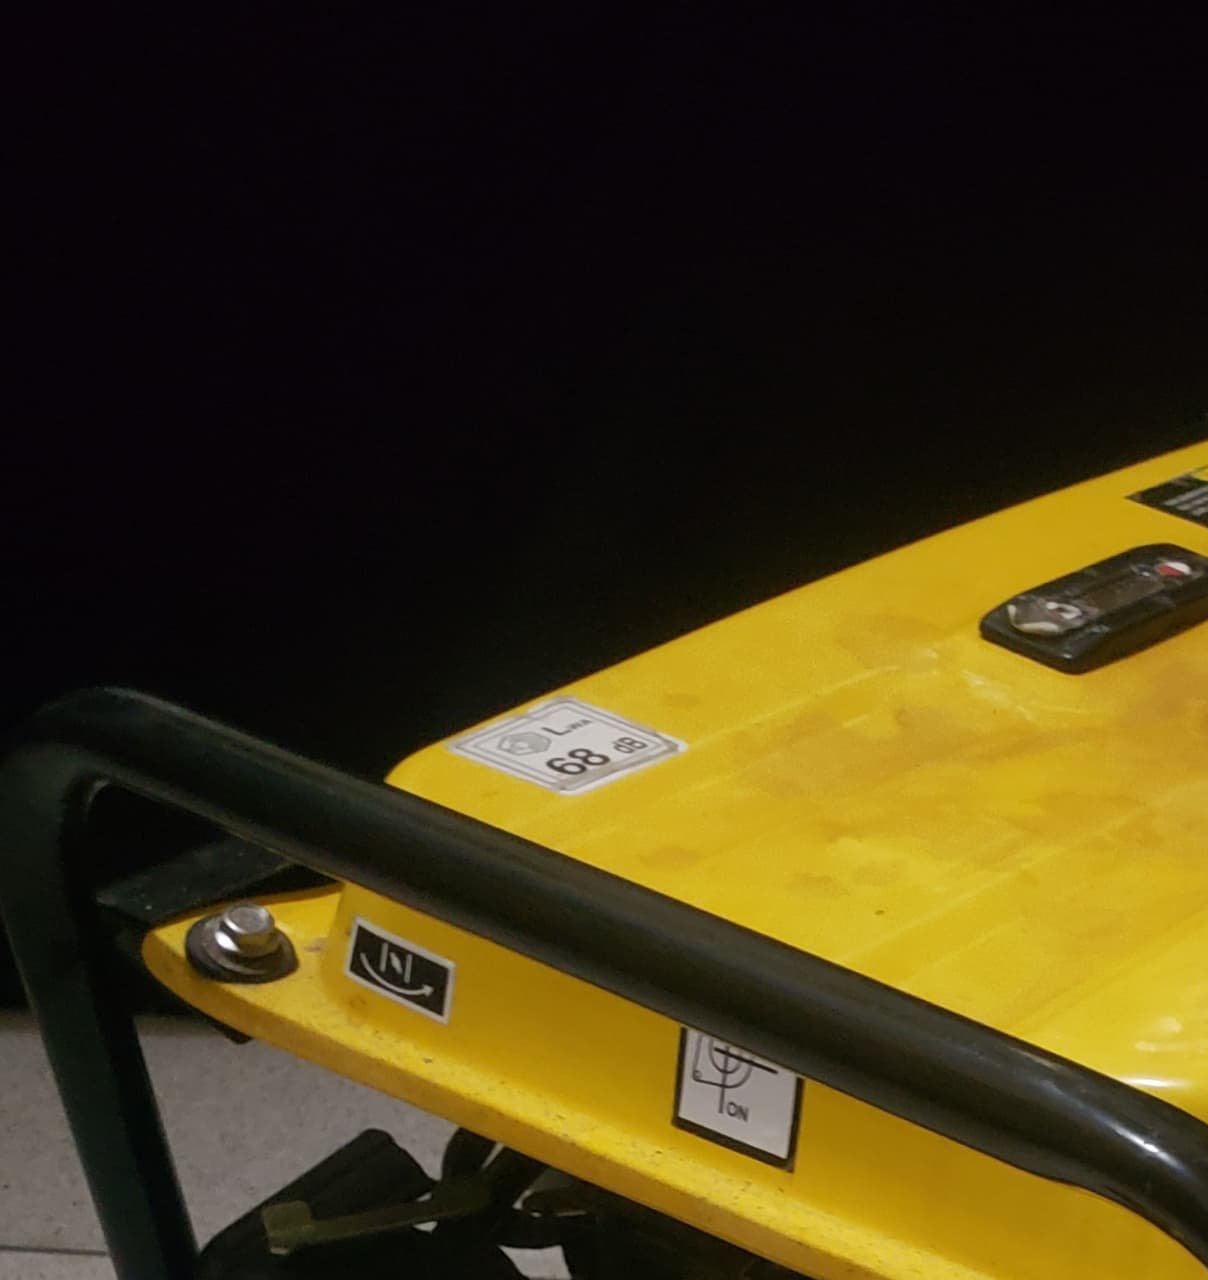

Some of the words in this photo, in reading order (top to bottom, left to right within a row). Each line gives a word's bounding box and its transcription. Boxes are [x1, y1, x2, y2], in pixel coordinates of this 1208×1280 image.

[546, 748, 611, 775] 68
[612, 737, 648, 754] dB
[726, 1101, 749, 1122] ON
